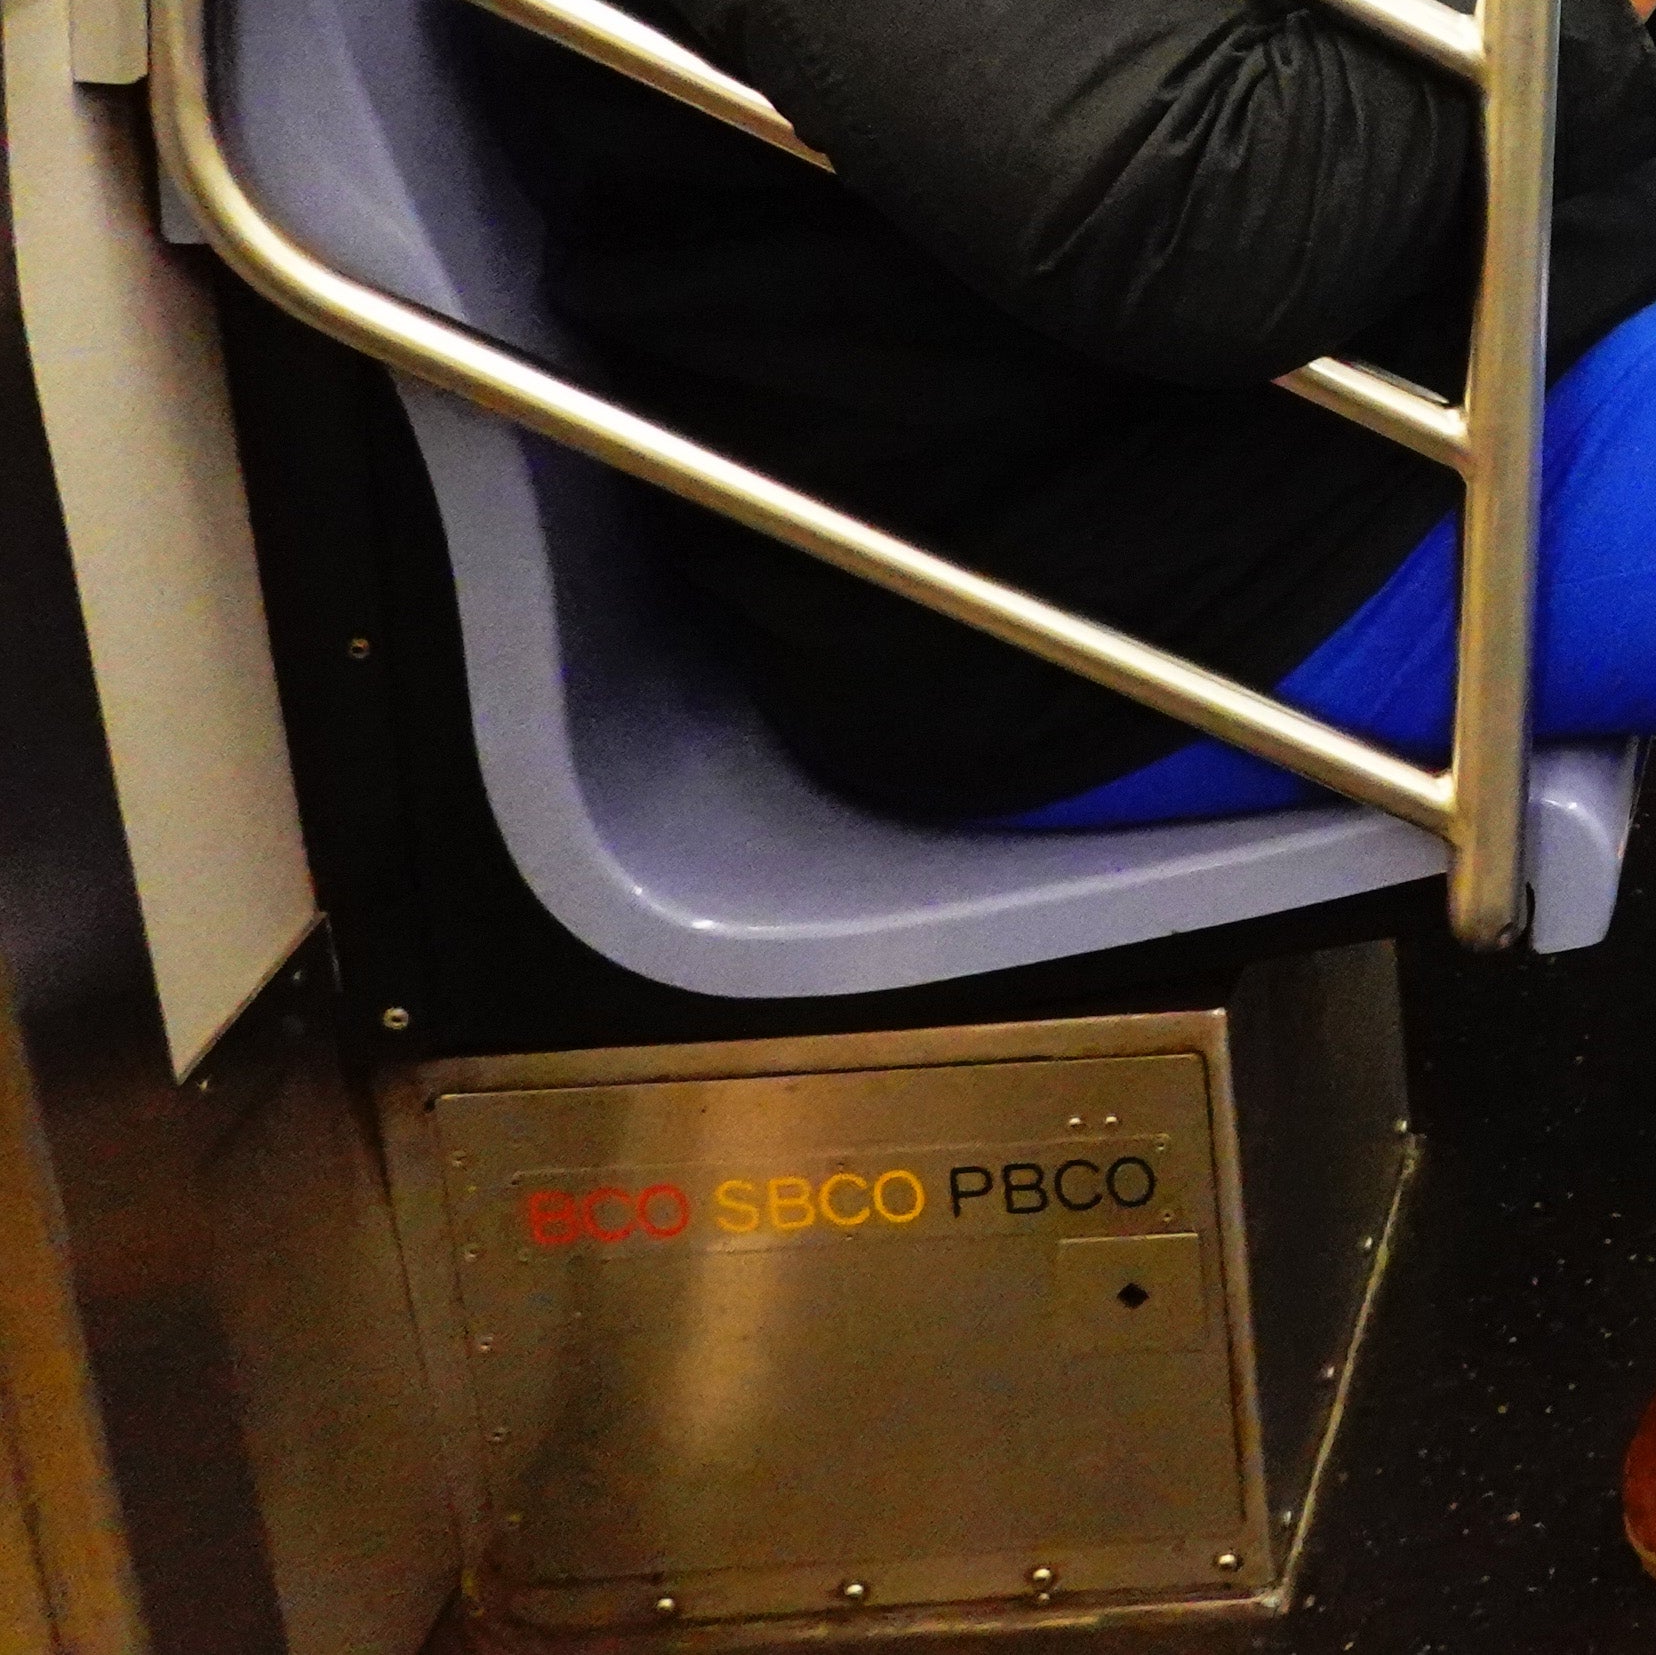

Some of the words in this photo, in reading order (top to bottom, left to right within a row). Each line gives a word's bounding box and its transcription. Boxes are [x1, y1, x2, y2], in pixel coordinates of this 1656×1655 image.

[526, 1184, 691, 1245] BCO
[714, 1168, 927, 1234] SBCO
[949, 1156, 1156, 1218] PBCO
